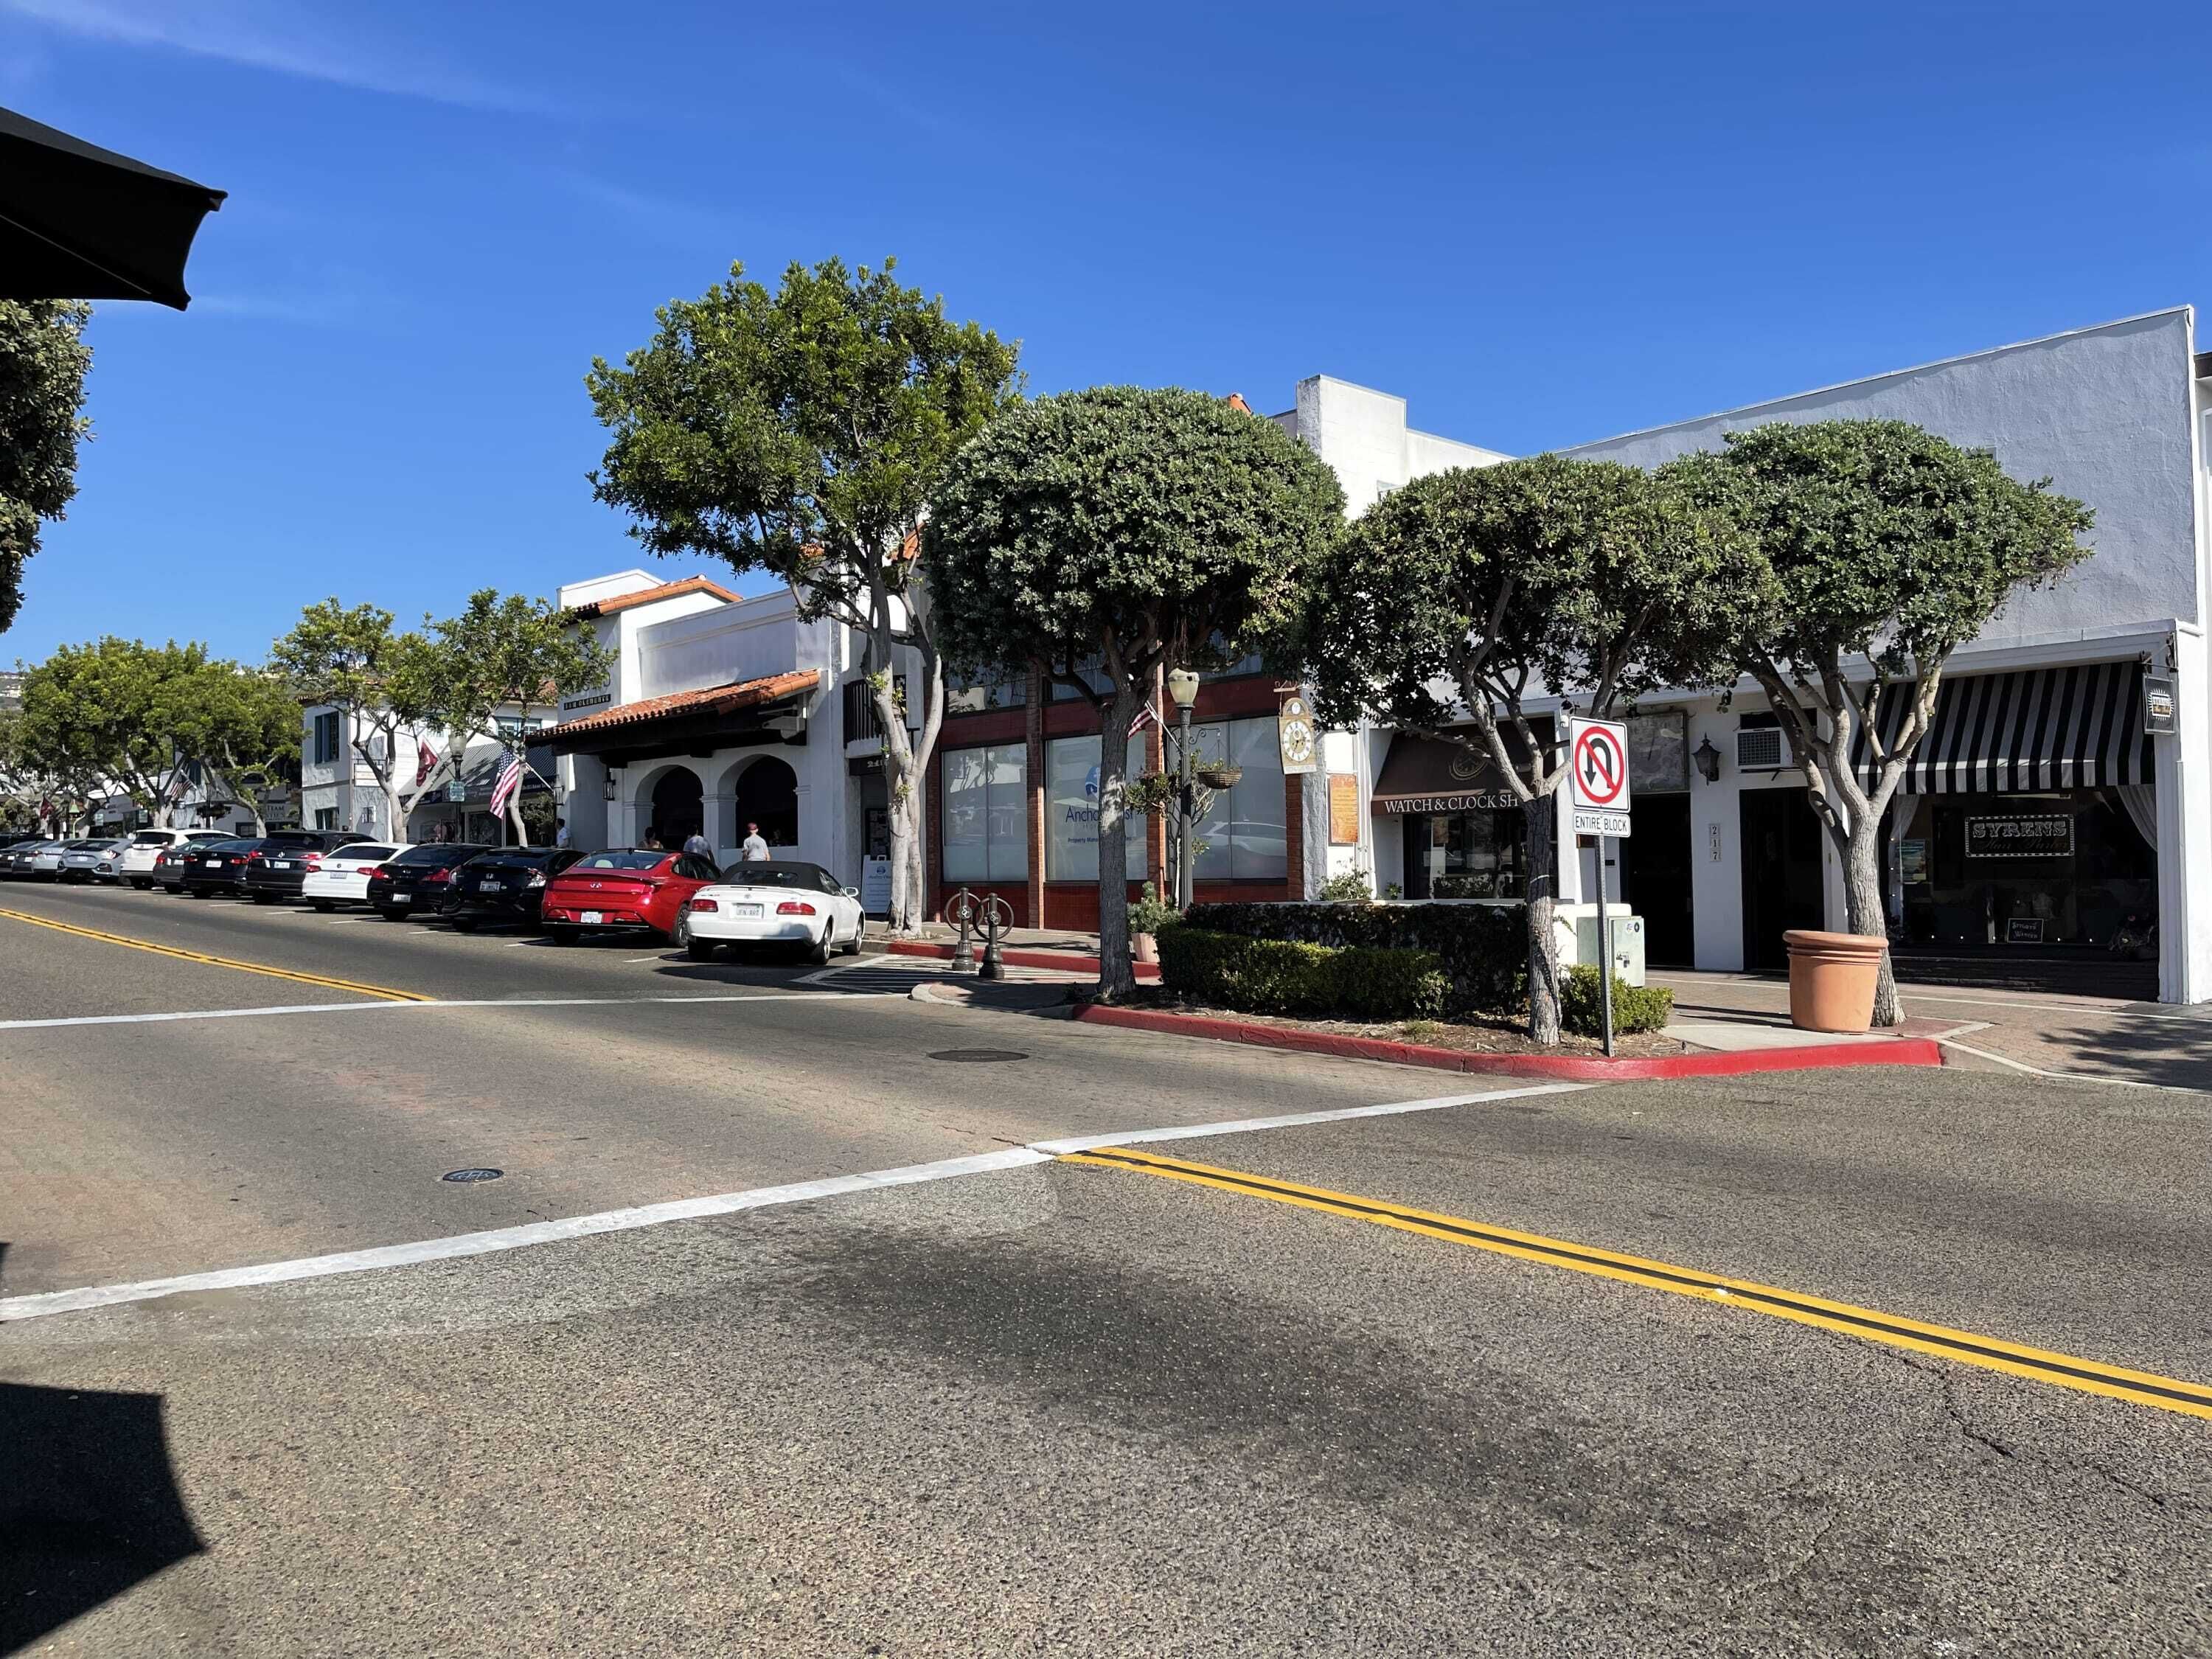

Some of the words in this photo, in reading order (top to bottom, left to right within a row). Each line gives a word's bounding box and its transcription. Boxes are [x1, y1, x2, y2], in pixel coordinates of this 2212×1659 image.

[1385, 799, 1433, 813] WATCH
[1435, 799, 1446, 810] &
[1447, 795, 1498, 810] CLOCK
[1500, 794, 1518, 808] SH
[1575, 815, 1601, 830] ENTIRE
[1604, 818, 1627, 832] BLOCK
[1972, 821, 2067, 838] SYRENS
